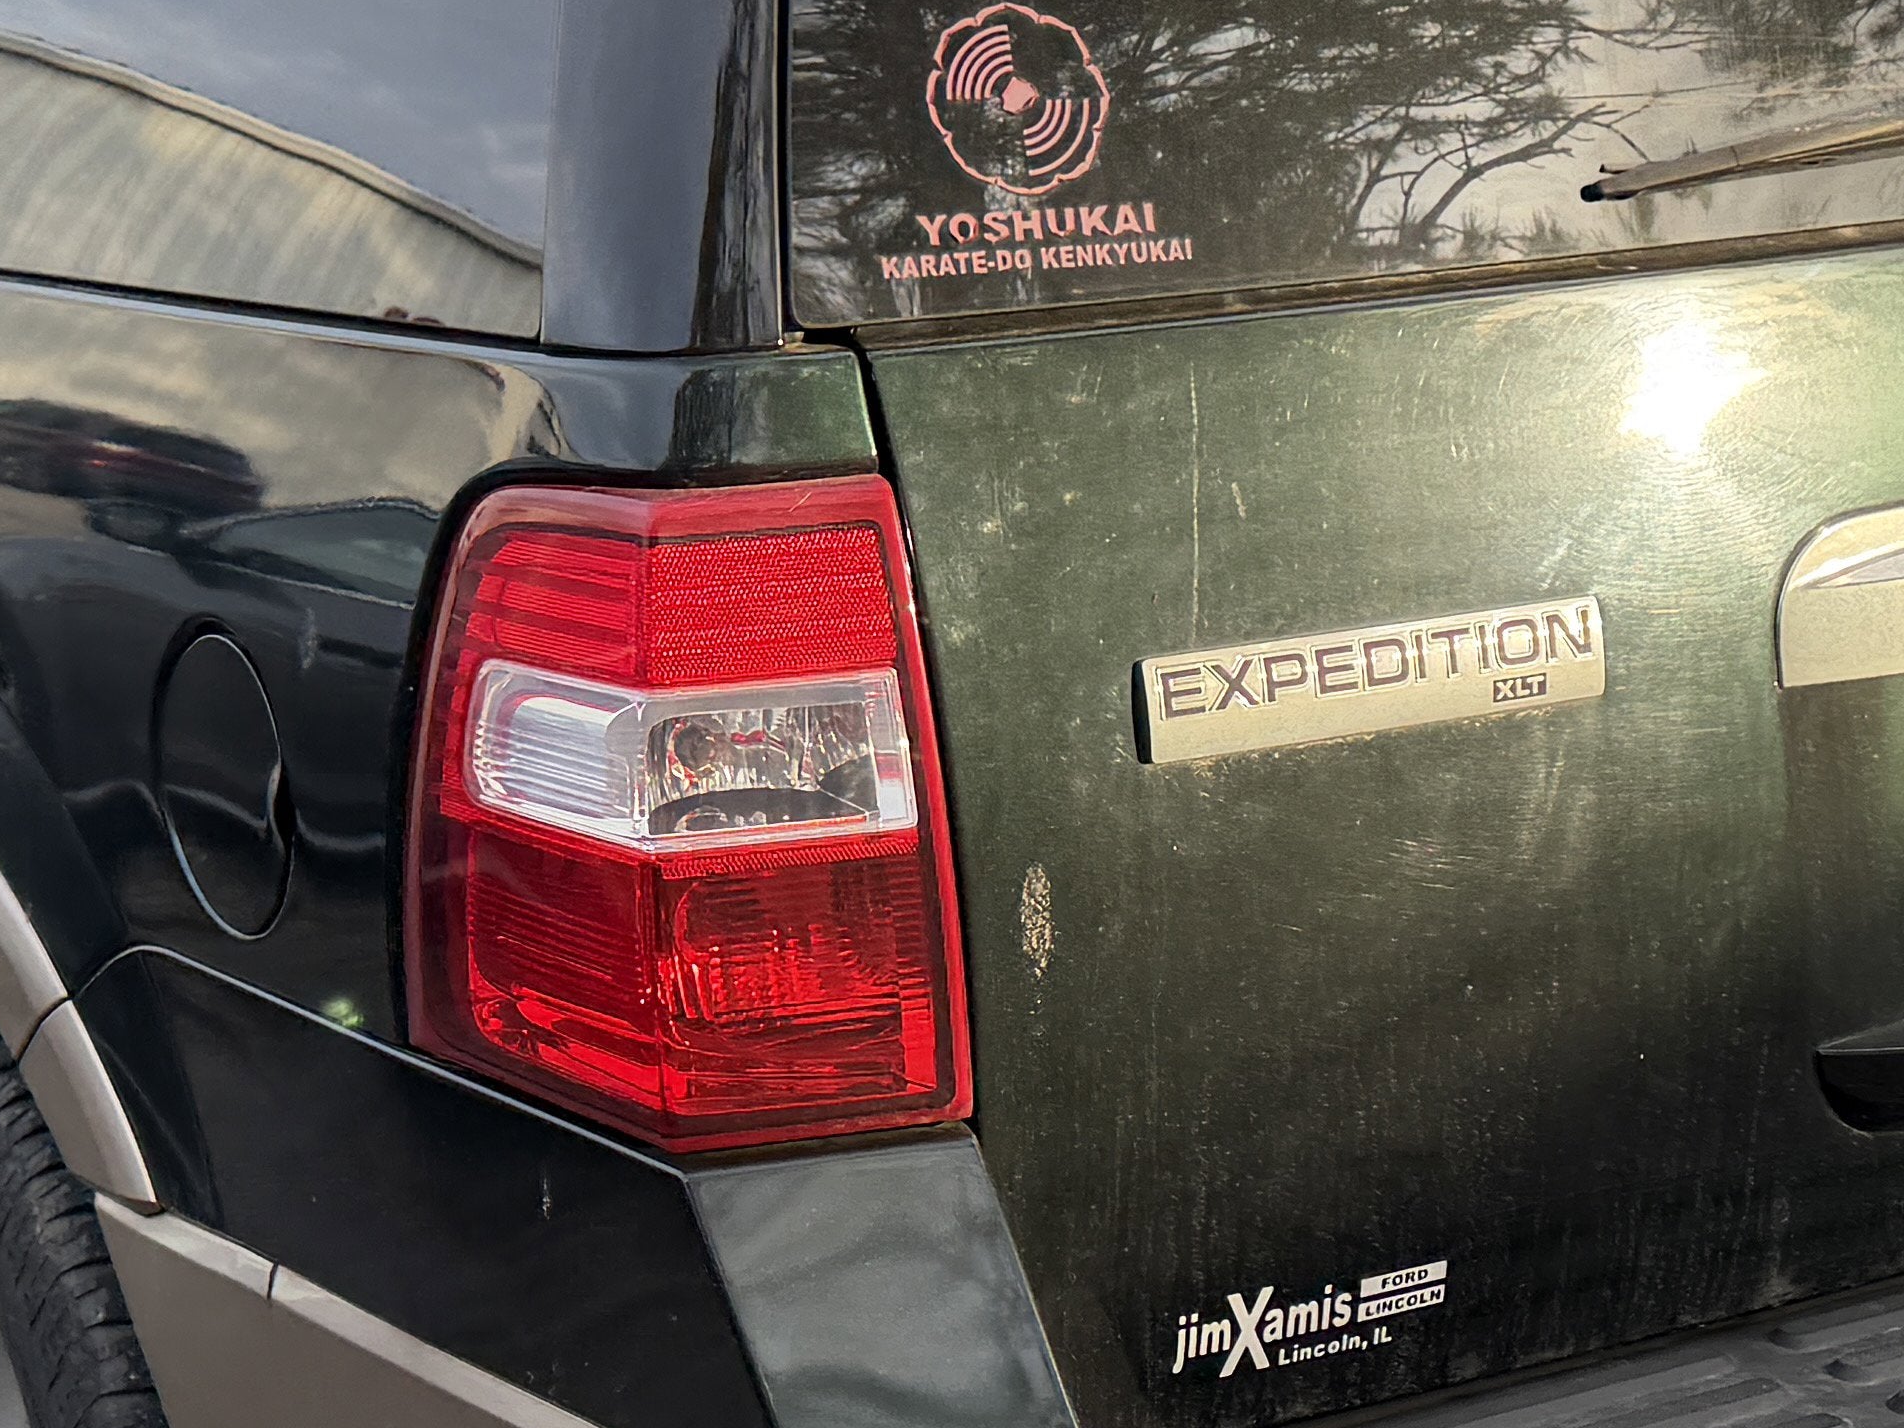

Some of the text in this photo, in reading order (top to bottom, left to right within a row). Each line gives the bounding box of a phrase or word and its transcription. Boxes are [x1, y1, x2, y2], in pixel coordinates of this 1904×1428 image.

[916, 202, 1156, 246] YOSHUKAI
[881, 238, 1193, 279] KARATE-DO KENKYUKAI
[1158, 605, 1595, 721] EXPEDITION
[1494, 674, 1546, 702] XLT
[1381, 1267, 1429, 1291] FORD
[1365, 1288, 1442, 1318] LINCOLN
[1277, 1325, 1393, 1367] Lincoln, IL
